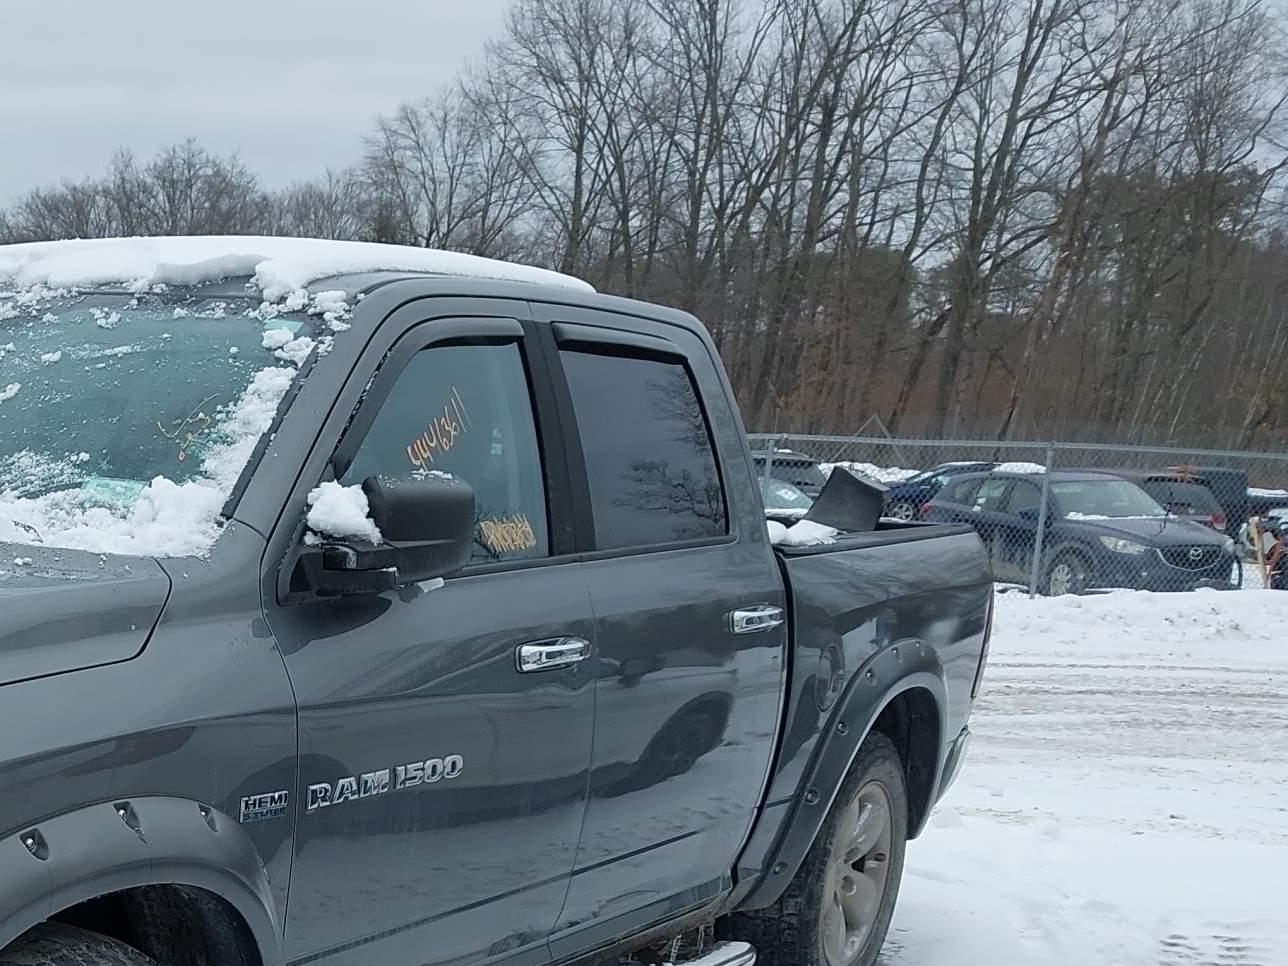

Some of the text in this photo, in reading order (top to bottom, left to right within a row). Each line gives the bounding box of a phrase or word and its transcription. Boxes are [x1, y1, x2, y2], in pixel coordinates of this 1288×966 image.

[406, 385, 472, 472] 44463611
[243, 791, 289, 811] HEMI
[308, 753, 464, 810] RAM 1500
